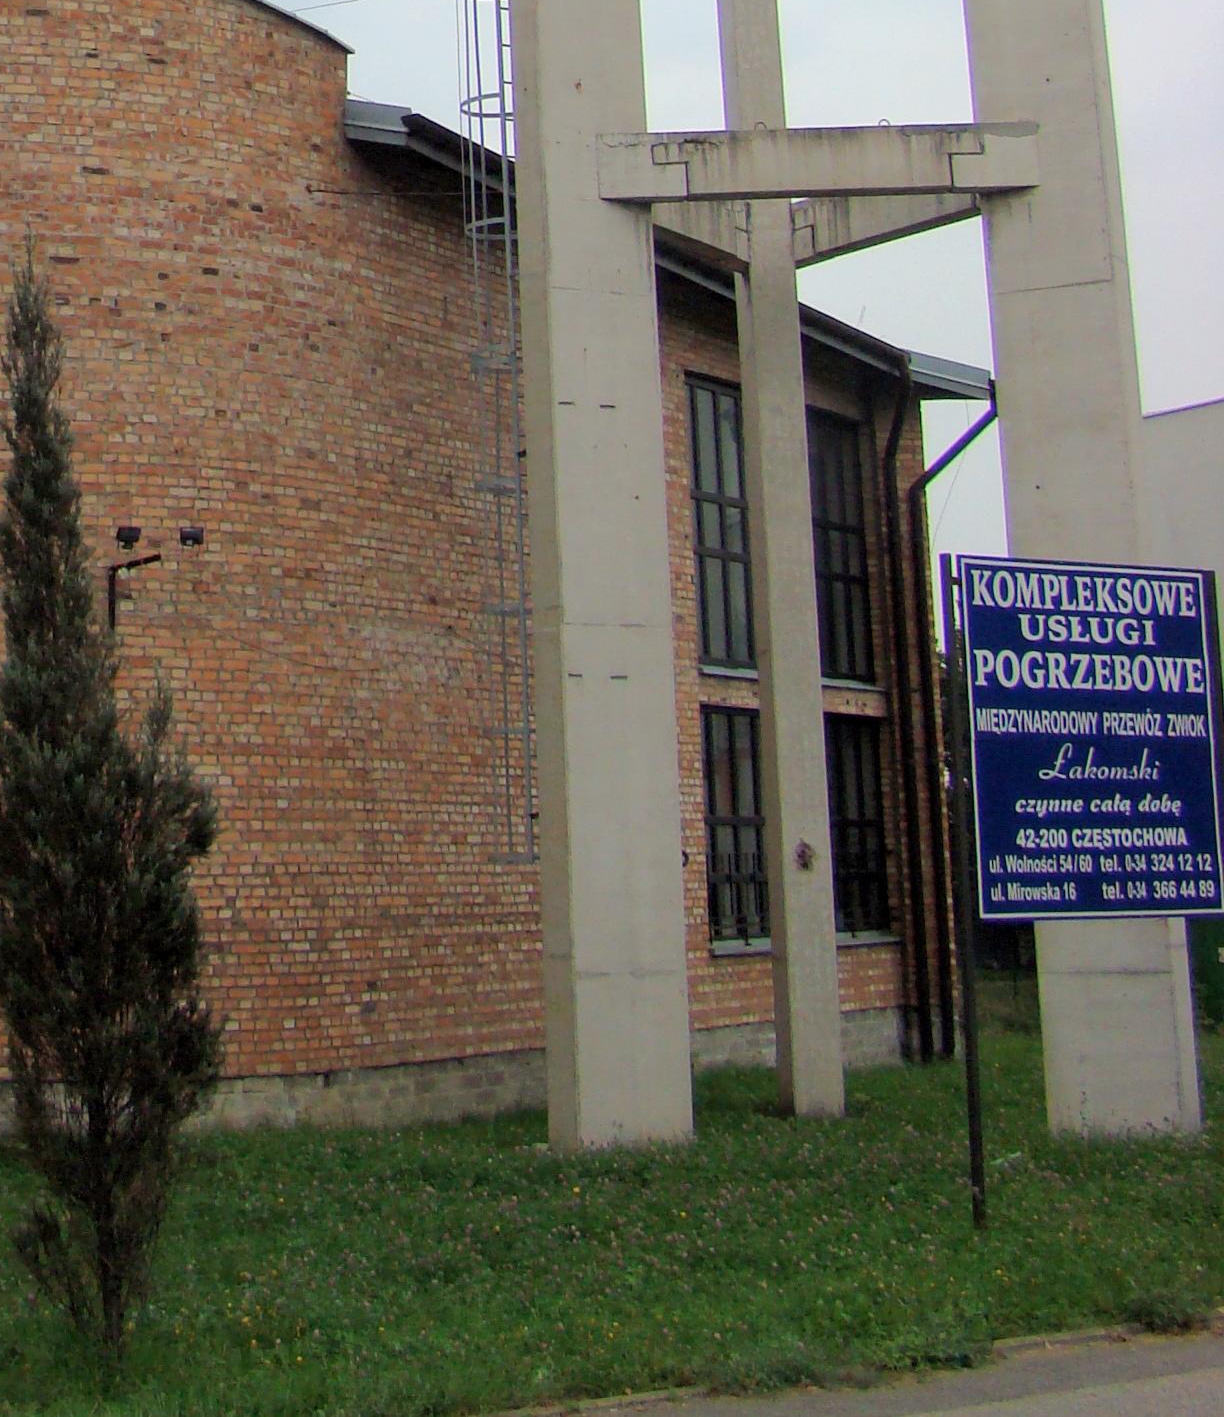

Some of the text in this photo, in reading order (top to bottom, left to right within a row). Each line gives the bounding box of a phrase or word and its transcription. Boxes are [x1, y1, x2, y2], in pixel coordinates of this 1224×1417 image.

[971, 569, 1197, 617] KOMPLEKSOWE
[1018, 613, 1157, 646] USŁUGI
[973, 648, 1205, 694] POGRZEBOWE
[976, 708, 1098, 735] MIĘDZYNARODOWY
[1103, 708, 1163, 737] PRZEWÓZ
[1038, 742, 1161, 781] Łakomski
[1015, 793, 1183, 818] czynne całą dobę
[1016, 827, 1189, 851] 42-200 CZĘSTOCHOWA
[989, 855, 1004, 874] ul.
[1005, 854, 1058, 874] Wolności
[1099, 854, 1123, 873] tel.
[1124, 854, 1147, 873] 0-34
[1150, 853, 1176, 872] 324
[1177, 853, 1194, 872] 12
[1196, 853, 1213, 872] 12
[990, 879, 1216, 902] ul. Mirowska 16 tel. 0-34 366 44 89
